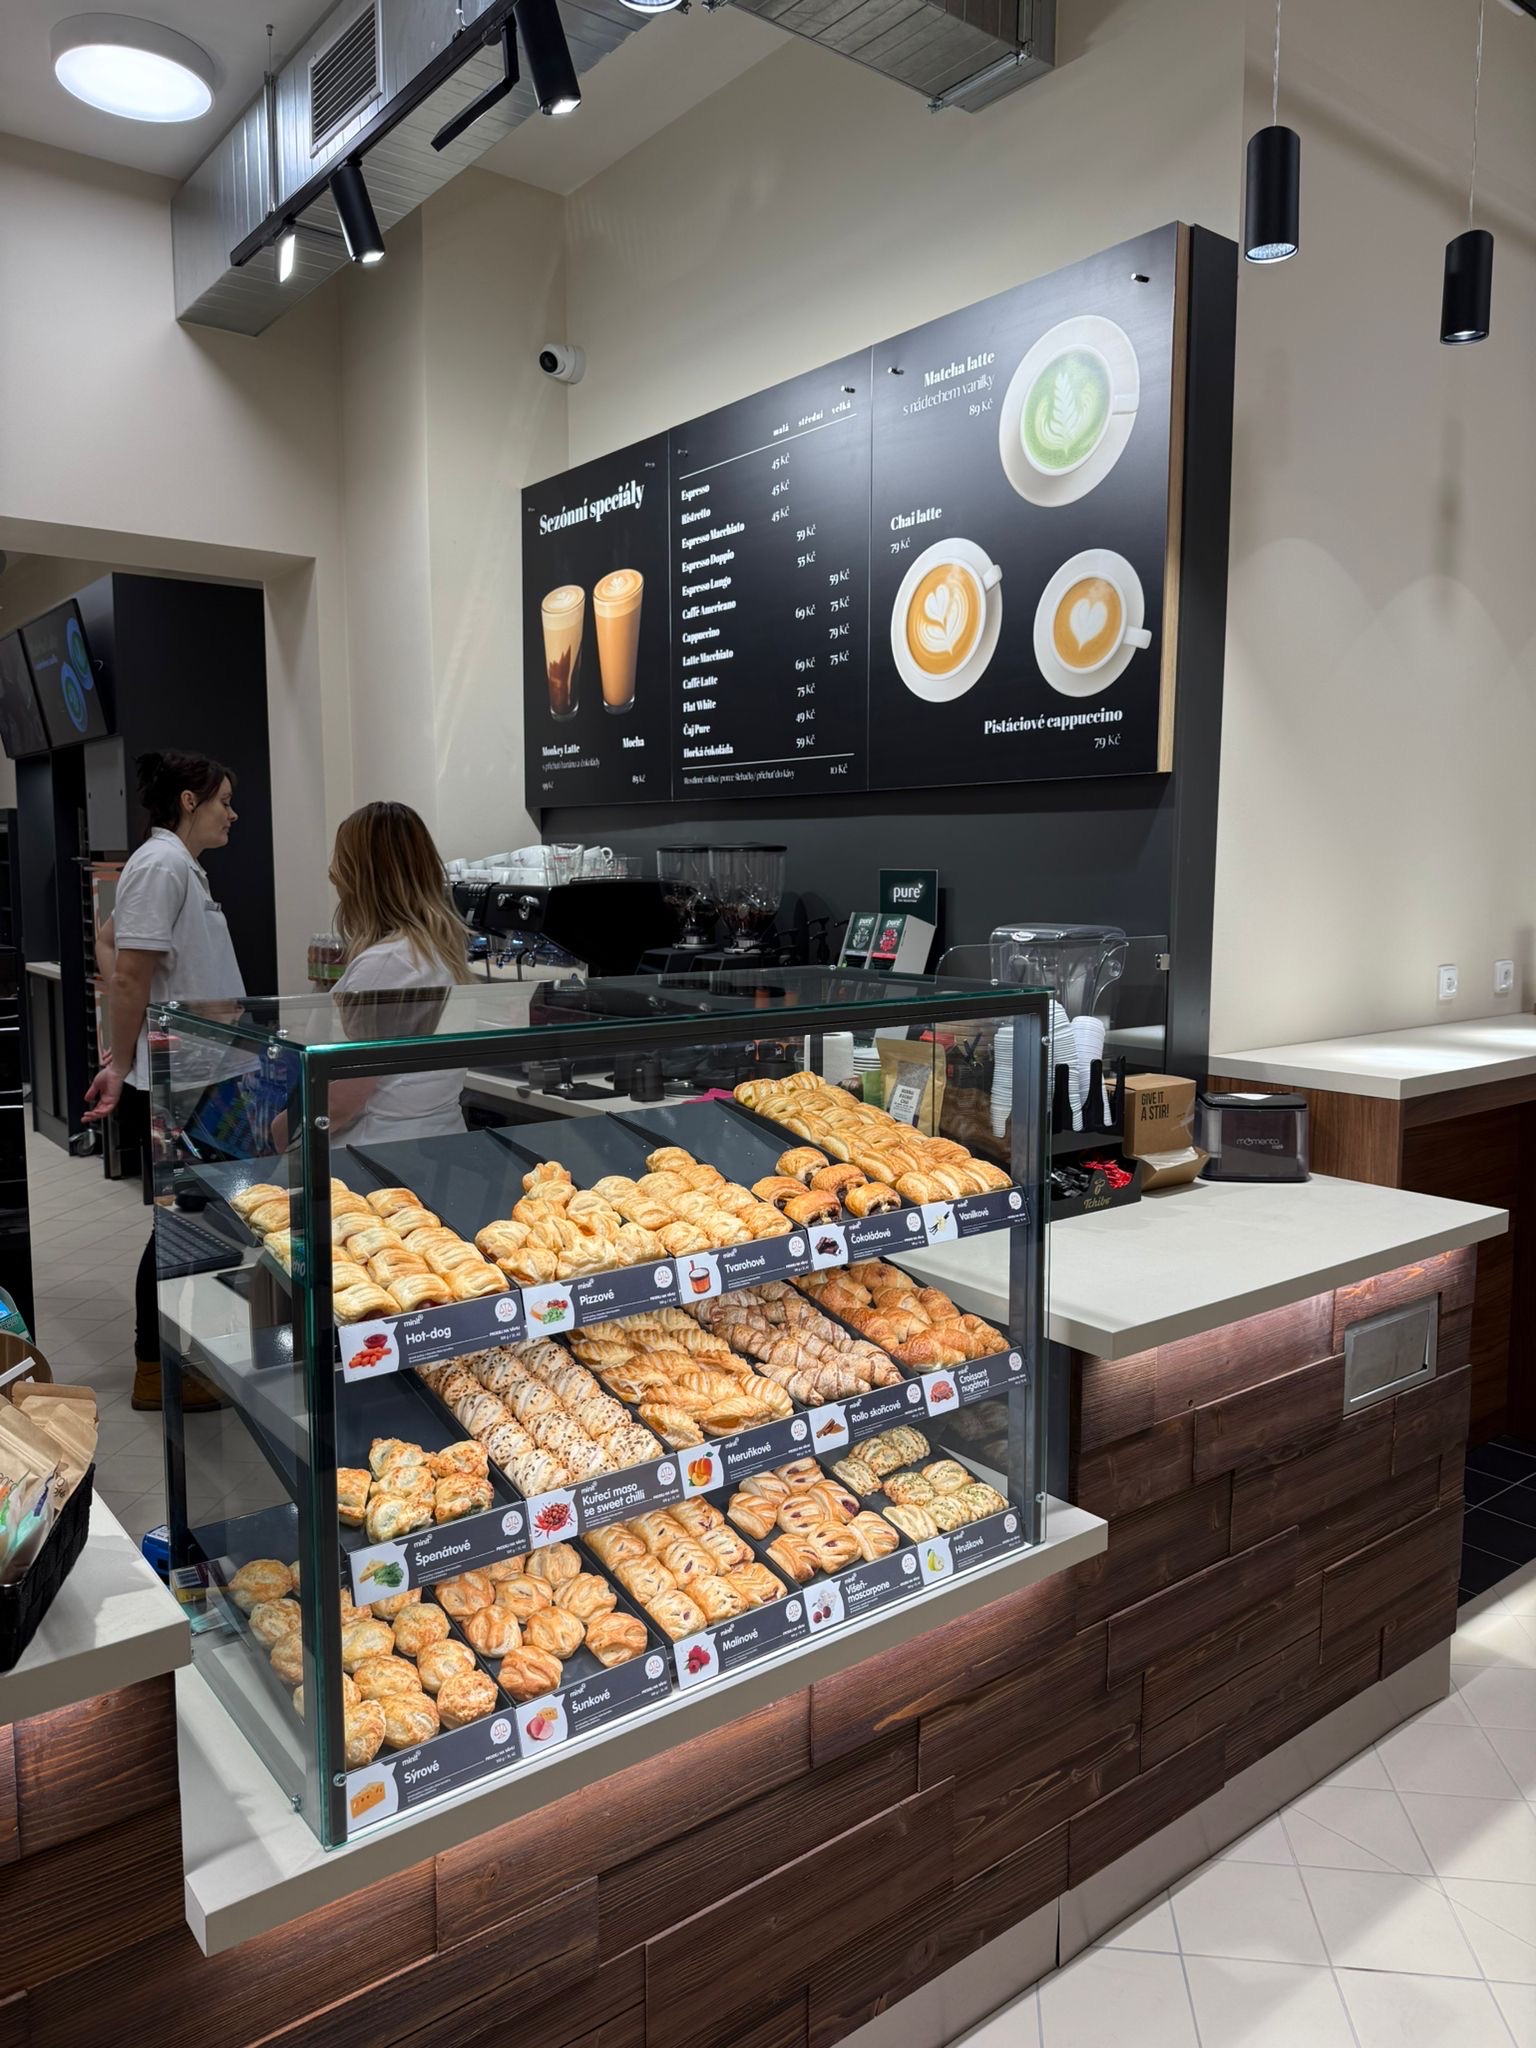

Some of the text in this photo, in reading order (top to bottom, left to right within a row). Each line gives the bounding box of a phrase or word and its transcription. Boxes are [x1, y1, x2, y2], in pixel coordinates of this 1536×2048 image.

[924, 352, 995, 388] Matcha latte
[903, 374, 995, 416] s nádechem vanilky
[969, 398, 994, 417] 89 Kč
[773, 422, 790, 436] malá
[832, 400, 851, 414] velká
[772, 452, 790, 470] 45 Kč
[681, 484, 710, 502] Espresso
[772, 479, 790, 497] 45 Kč
[540, 480, 644, 535] Sezónní speciály
[772, 506, 790, 523] 45 Kč
[681, 508, 711, 526] Ristretto
[890, 507, 942, 530] Chai latte
[682, 522, 745, 550] Espresso Macchiato
[806, 524, 816, 536] Kč
[890, 537, 911, 554] 79 Kč
[682, 550, 734, 574] Espresso Doppio
[806, 551, 816, 564] Kč
[829, 568, 850, 586] 59 Kč
[682, 576, 732, 598] Espresso Lungo
[700, 600, 736, 616] Americano
[840, 596, 850, 608] Kč
[796, 604, 816, 620] 69 Kč
[682, 627, 720, 644] Cappuccino
[829, 623, 850, 640] 79 Kč
[682, 649, 734, 667] Latte Macchiato
[796, 656, 816, 672] 69 Kč
[840, 650, 850, 662] Kč
[700, 675, 718, 687] Latte
[806, 682, 816, 694] Kč
[683, 699, 717, 712] Flat White
[806, 708, 816, 720] Kč
[984, 707, 1123, 734] Pistáciové cappuccino
[683, 722, 710, 738] Čaj Pure
[622, 736, 644, 748] Mocha
[806, 734, 816, 746] Kč
[1094, 734, 1121, 748] 79 Kč
[542, 744, 580, 758] Monkey Latte
[684, 743, 734, 758] Horká čokoláda
[838, 763, 848, 774] Kč
[548, 781, 554, 789] Kč
[639, 774, 646, 782] Kč
[893, 886, 921, 903] pure
[1142, 1091, 1164, 1106] GIVE IT
[1141, 1106, 1147, 1121] A
[1149, 1104, 1169, 1120] STIR!
[959, 1208, 990, 1222] Vanilkové
[850, 1228, 892, 1245] Čokoládové
[724, 1256, 766, 1274] Tvarohové
[580, 1289, 615, 1306] Pizzové
[406, 1326, 452, 1345] Hot-dog
[960, 1369, 988, 1384] Croissant
[962, 1378, 990, 1394] nugátový
[851, 1410, 870, 1423] Rollo
[870, 1400, 901, 1418] skořicové
[727, 1442, 772, 1465] Meruňkové
[582, 1488, 611, 1506] Kuřecí
[612, 1482, 638, 1496] maso
[584, 1508, 595, 1518] se
[597, 1498, 624, 1514] sweet
[625, 1489, 646, 1504] chilli
[955, 1536, 984, 1554] Hruškové
[415, 1540, 471, 1568] Špenátové
[846, 1578, 868, 1594] Višeň-
[848, 1581, 890, 1603] mascarpone
[722, 1628, 759, 1652] Malinové
[572, 1689, 611, 1714] Šunkové
[404, 1760, 440, 1784] Sýrové
